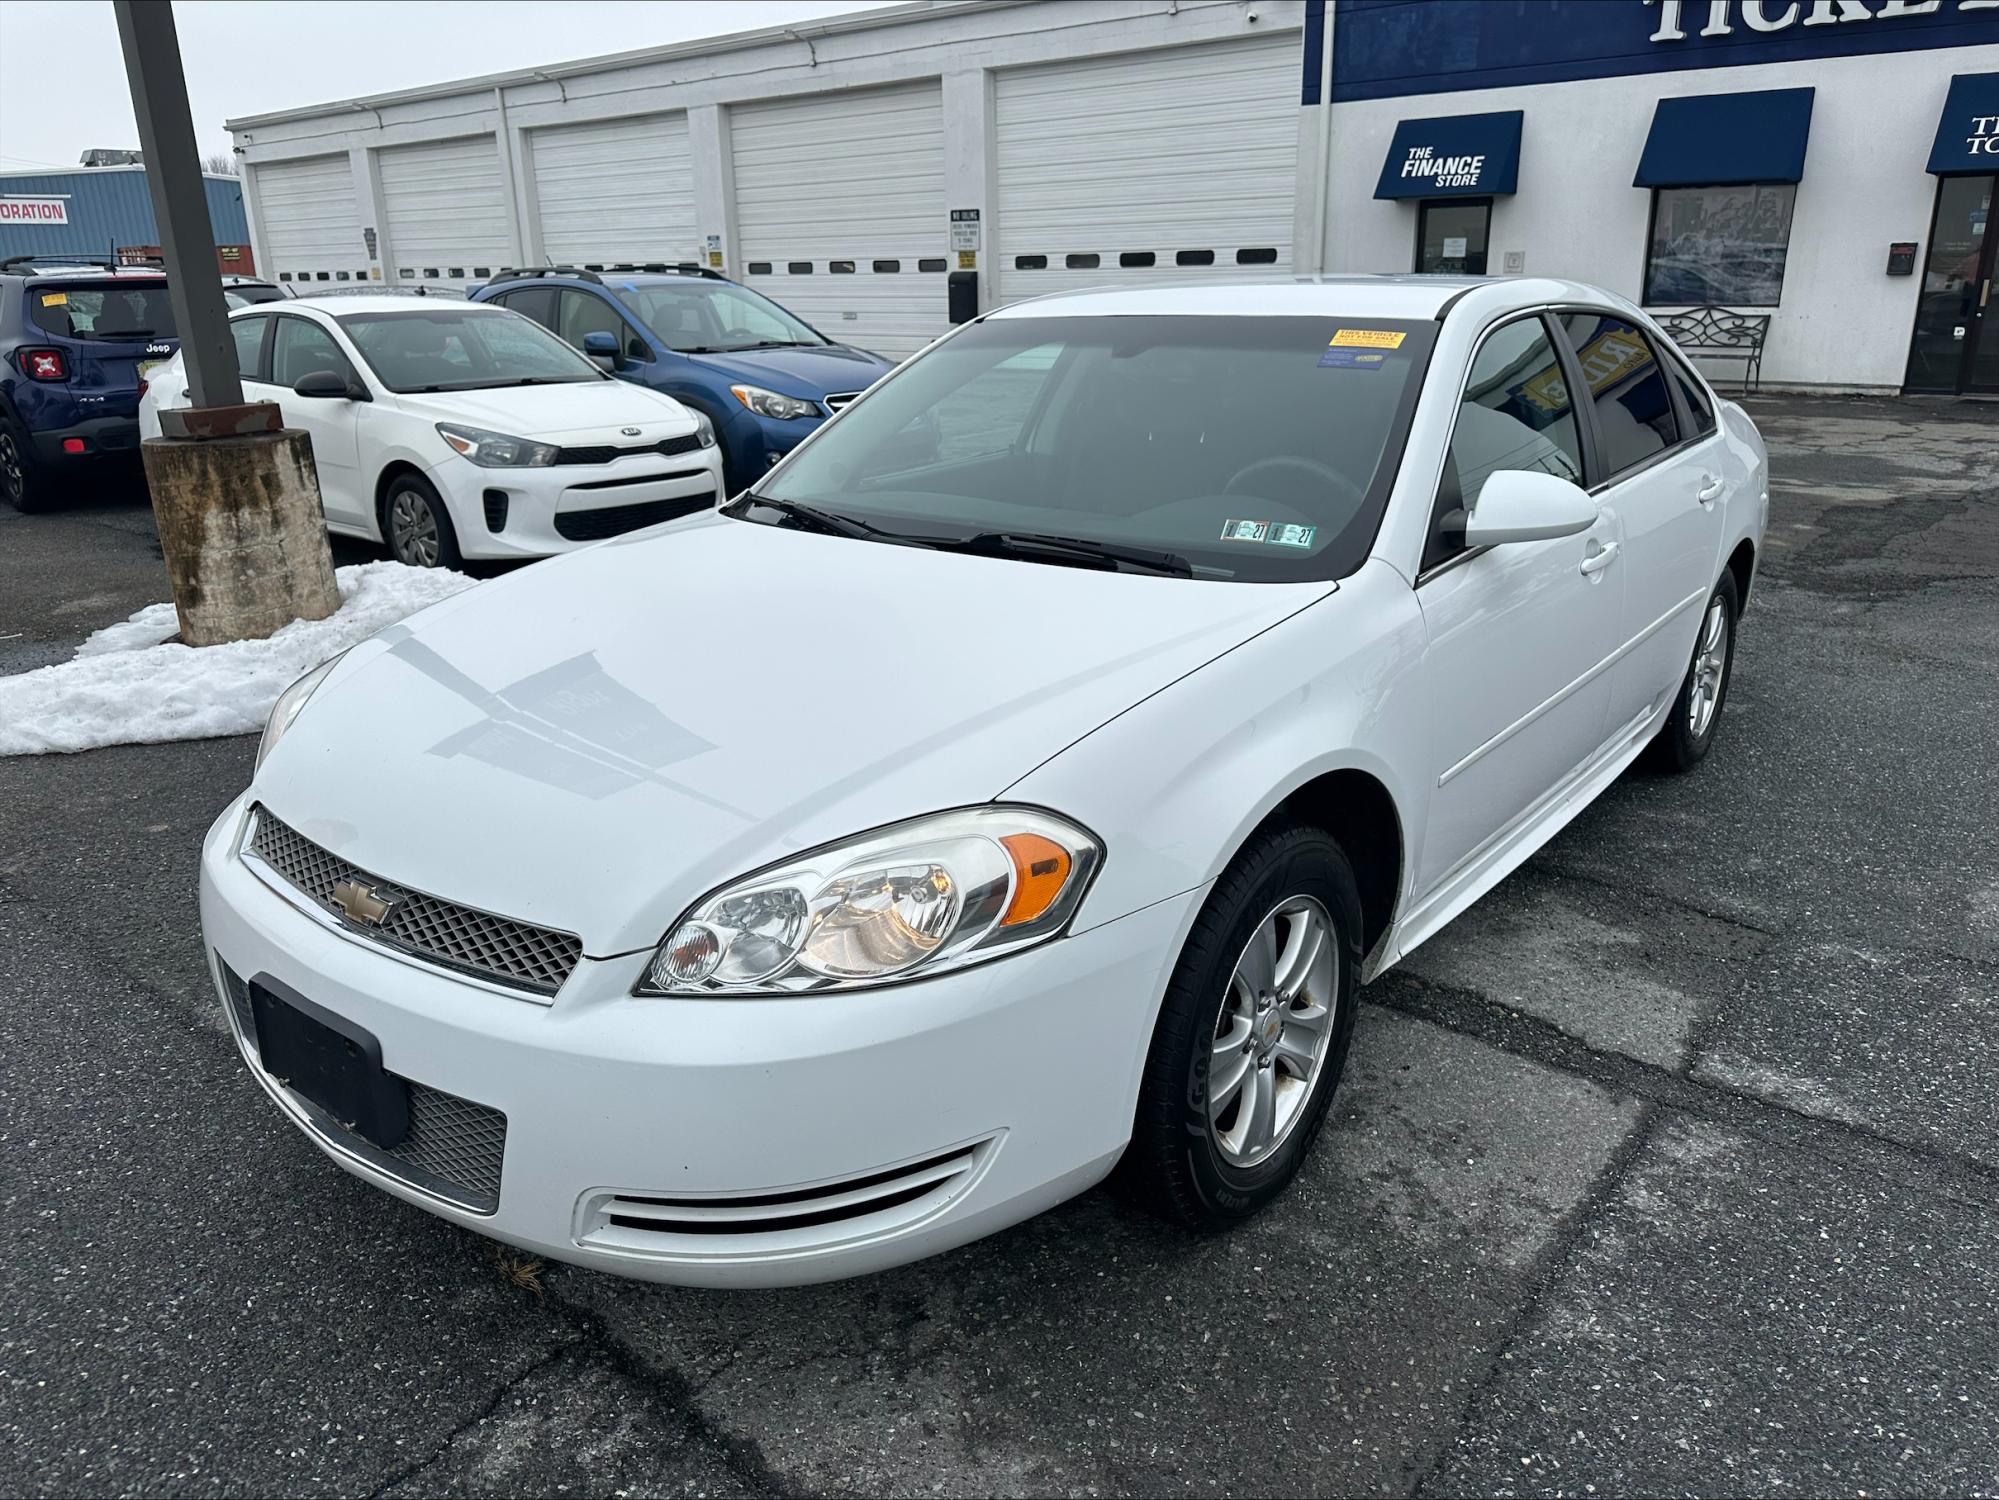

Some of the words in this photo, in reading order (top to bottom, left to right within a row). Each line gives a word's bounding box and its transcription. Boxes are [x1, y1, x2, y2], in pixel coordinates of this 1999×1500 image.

[1408, 146, 1434, 160] THE
[1401, 156, 1486, 178] FINANCE
[1435, 174, 1480, 187] STORE
[0, 203, 63, 219] ORATION
[146, 344, 170, 353] Jeep
[1252, 524, 1265, 539] 27
[1298, 528, 1312, 544] 27
